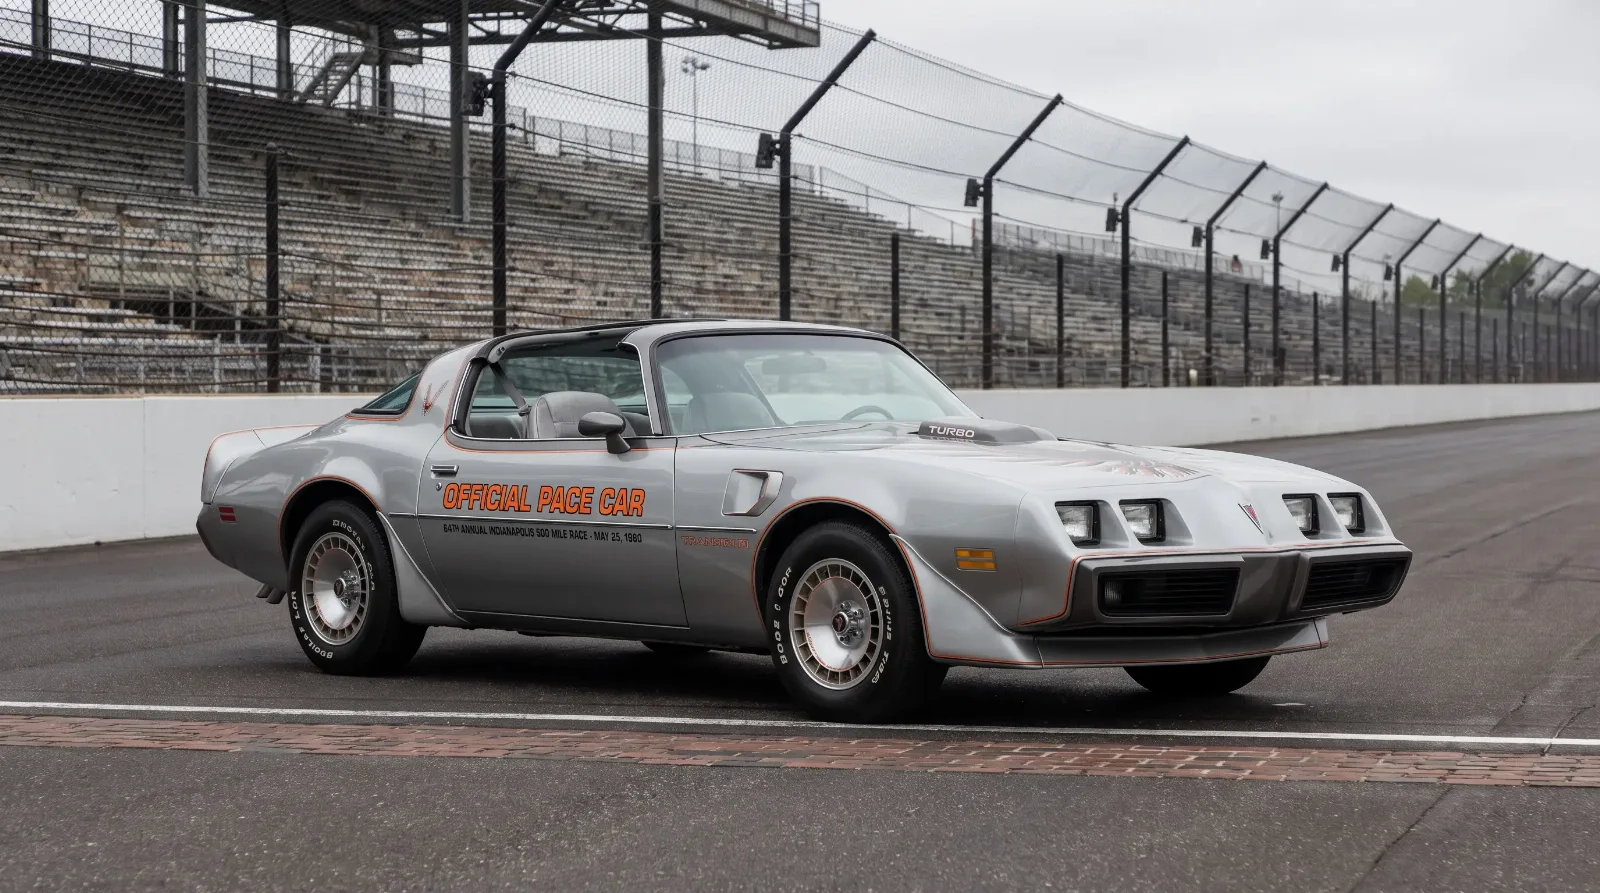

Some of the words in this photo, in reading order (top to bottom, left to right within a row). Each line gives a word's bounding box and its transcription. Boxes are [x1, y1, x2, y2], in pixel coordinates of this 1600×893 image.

[928, 425, 975, 438] TURBO
[443, 483, 531, 512] OFFICIAL
[537, 485, 595, 514] PACE
[599, 488, 645, 517] CAR
[443, 524, 460, 533] 64TH
[461, 525, 488, 535] ANNUAL
[489, 526, 535, 538] INDIANAPOLIS
[536, 528, 550, 538] 500
[551, 529, 568, 539] MILE
[569, 530, 588, 540] RACE
[594, 531, 609, 541] MAY
[611, 532, 623, 543] 25,
